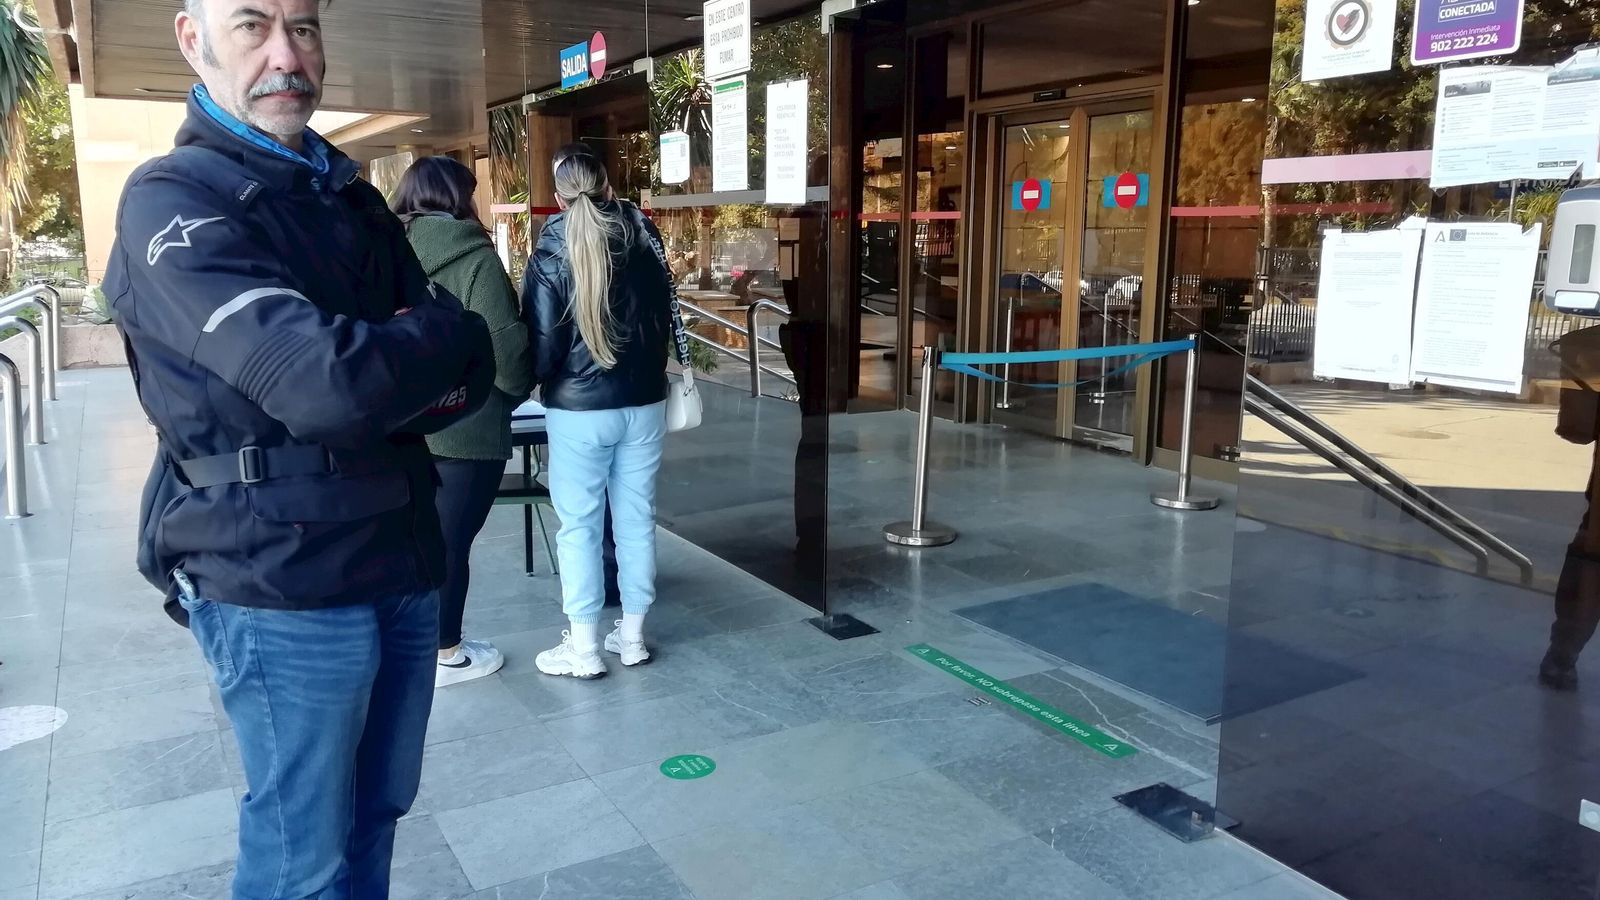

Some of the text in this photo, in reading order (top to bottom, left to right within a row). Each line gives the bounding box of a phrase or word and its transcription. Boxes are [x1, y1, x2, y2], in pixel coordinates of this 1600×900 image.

[708, 1, 744, 26] EN ESTE CENTRO
[1440, 3, 1495, 19] CONECTADA
[721, 24, 744, 42] PROHIBIDO
[1430, 24, 1501, 41] Intervención Inmediata
[1430, 33, 1498, 52] 902 222 224
[561, 52, 588, 79] SALIDA
[720, 49, 734, 64] FUMAR
[935, 656, 954, 667] Por
[975, 677, 994, 687] NO
[989, 685, 1040, 712] sobrepase
[1040, 710, 1064, 725] esta
